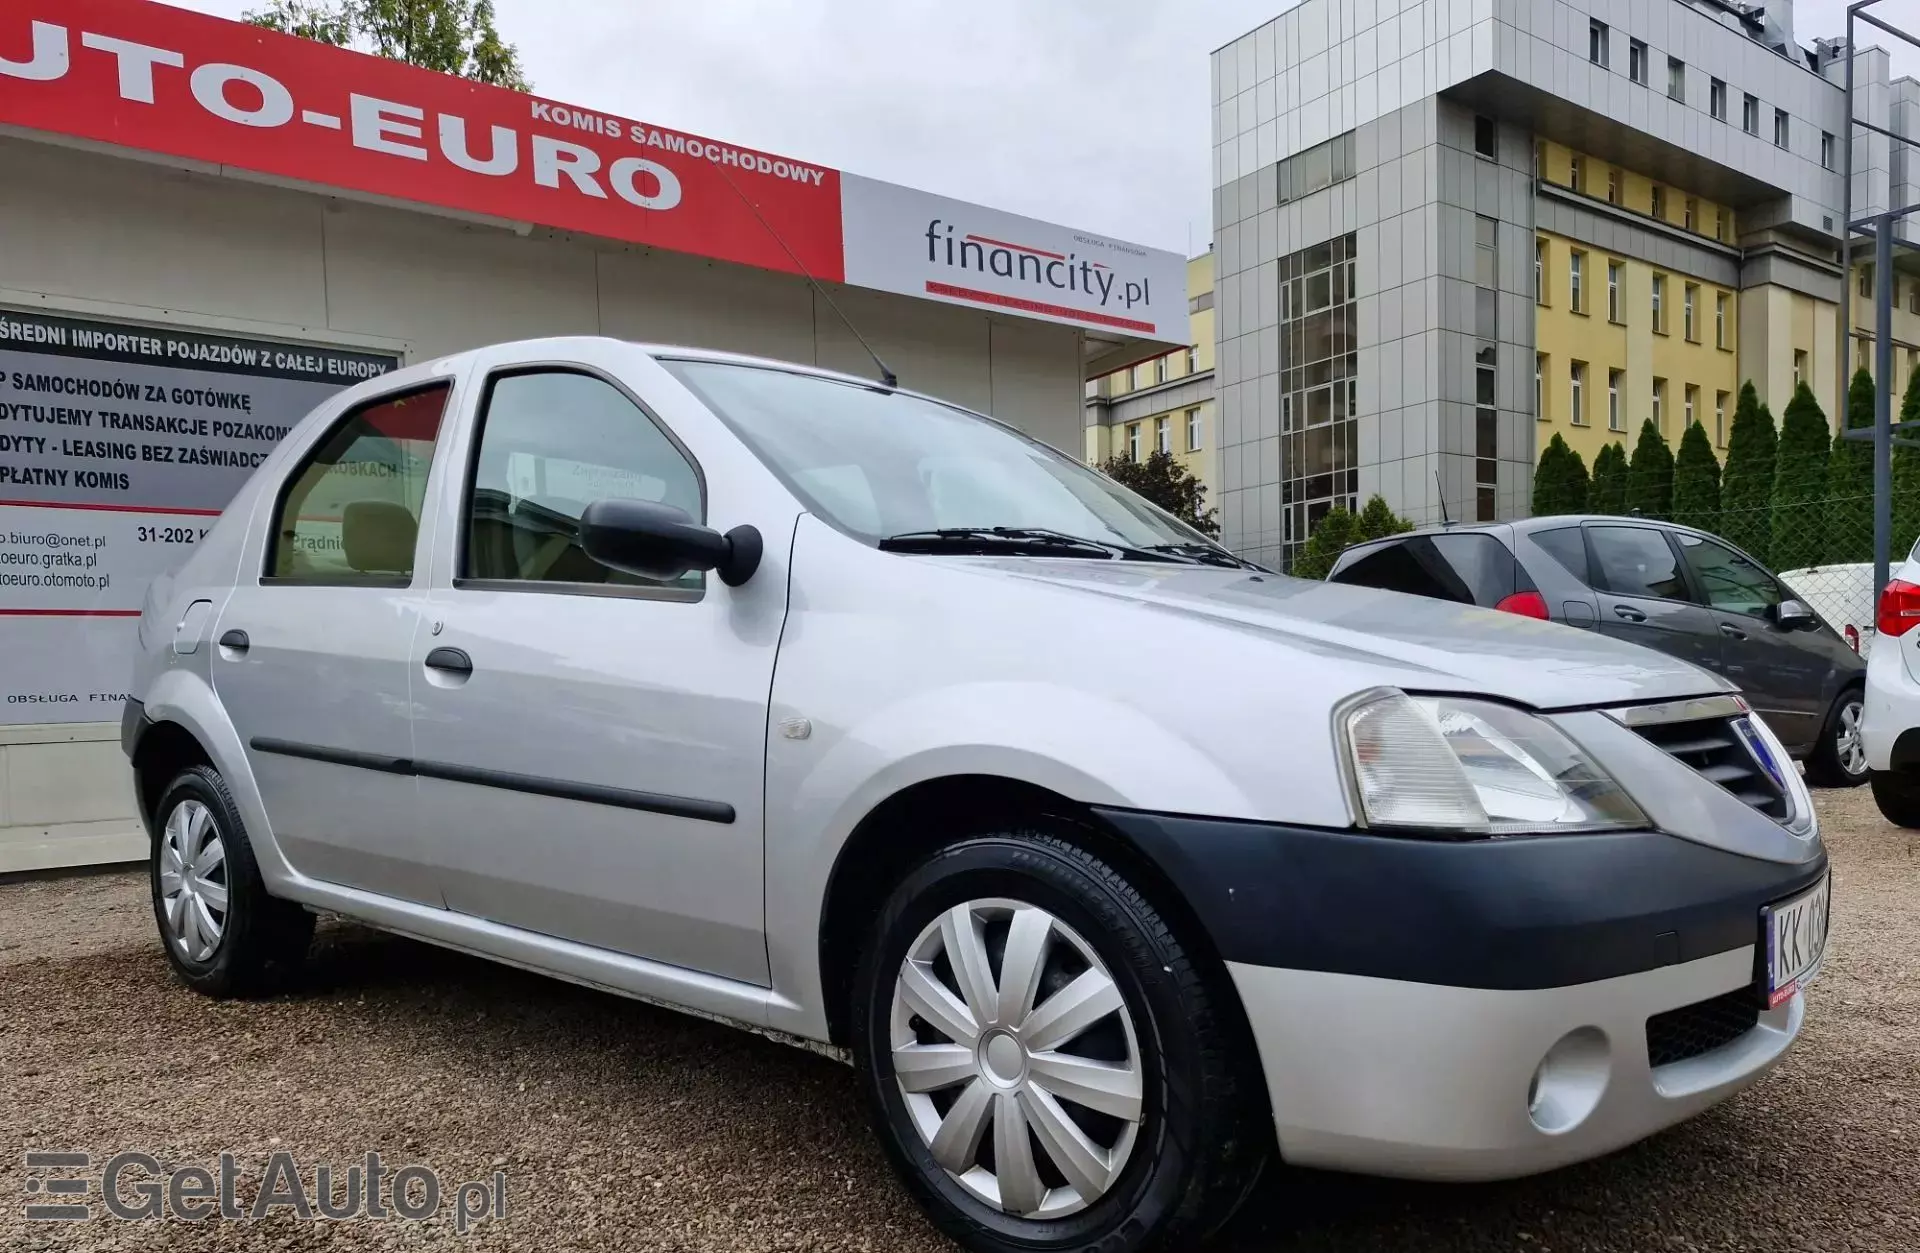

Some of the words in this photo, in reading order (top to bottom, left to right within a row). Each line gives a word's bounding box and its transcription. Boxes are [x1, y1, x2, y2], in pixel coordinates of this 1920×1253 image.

[532, 101, 622, 139] KOMIS
[630, 125, 825, 186] SAMOCHODOWY
[925, 219, 1150, 309] financity.pl
[72, 329, 163, 356] IMPORTER
[167, 340, 256, 366] POJAZDÓW
[260, 351, 272, 368] Z
[275, 352, 323, 373] CAŁEJ
[328, 358, 387, 378] EUROPY
[12, 372, 140, 401] SAMOCHODÓW
[144, 385, 167, 403] ZA
[172, 387, 251, 415] GOTÓWKĘ
[98, 411, 208, 436] TRANSAKCJE
[213, 420, 293, 441] POZAKOM
[0, 434, 46, 454] DYTY
[62, 439, 137, 461] LEASING
[142, 445, 174, 463] BEZ
[0, 466, 68, 487] PŁATNY
[74, 470, 130, 490] KOMIS
[138, 526, 194, 544] 31-202
[7, 694, 79, 703] OBSŁUGA
[89, 694, 131, 702] FINA
